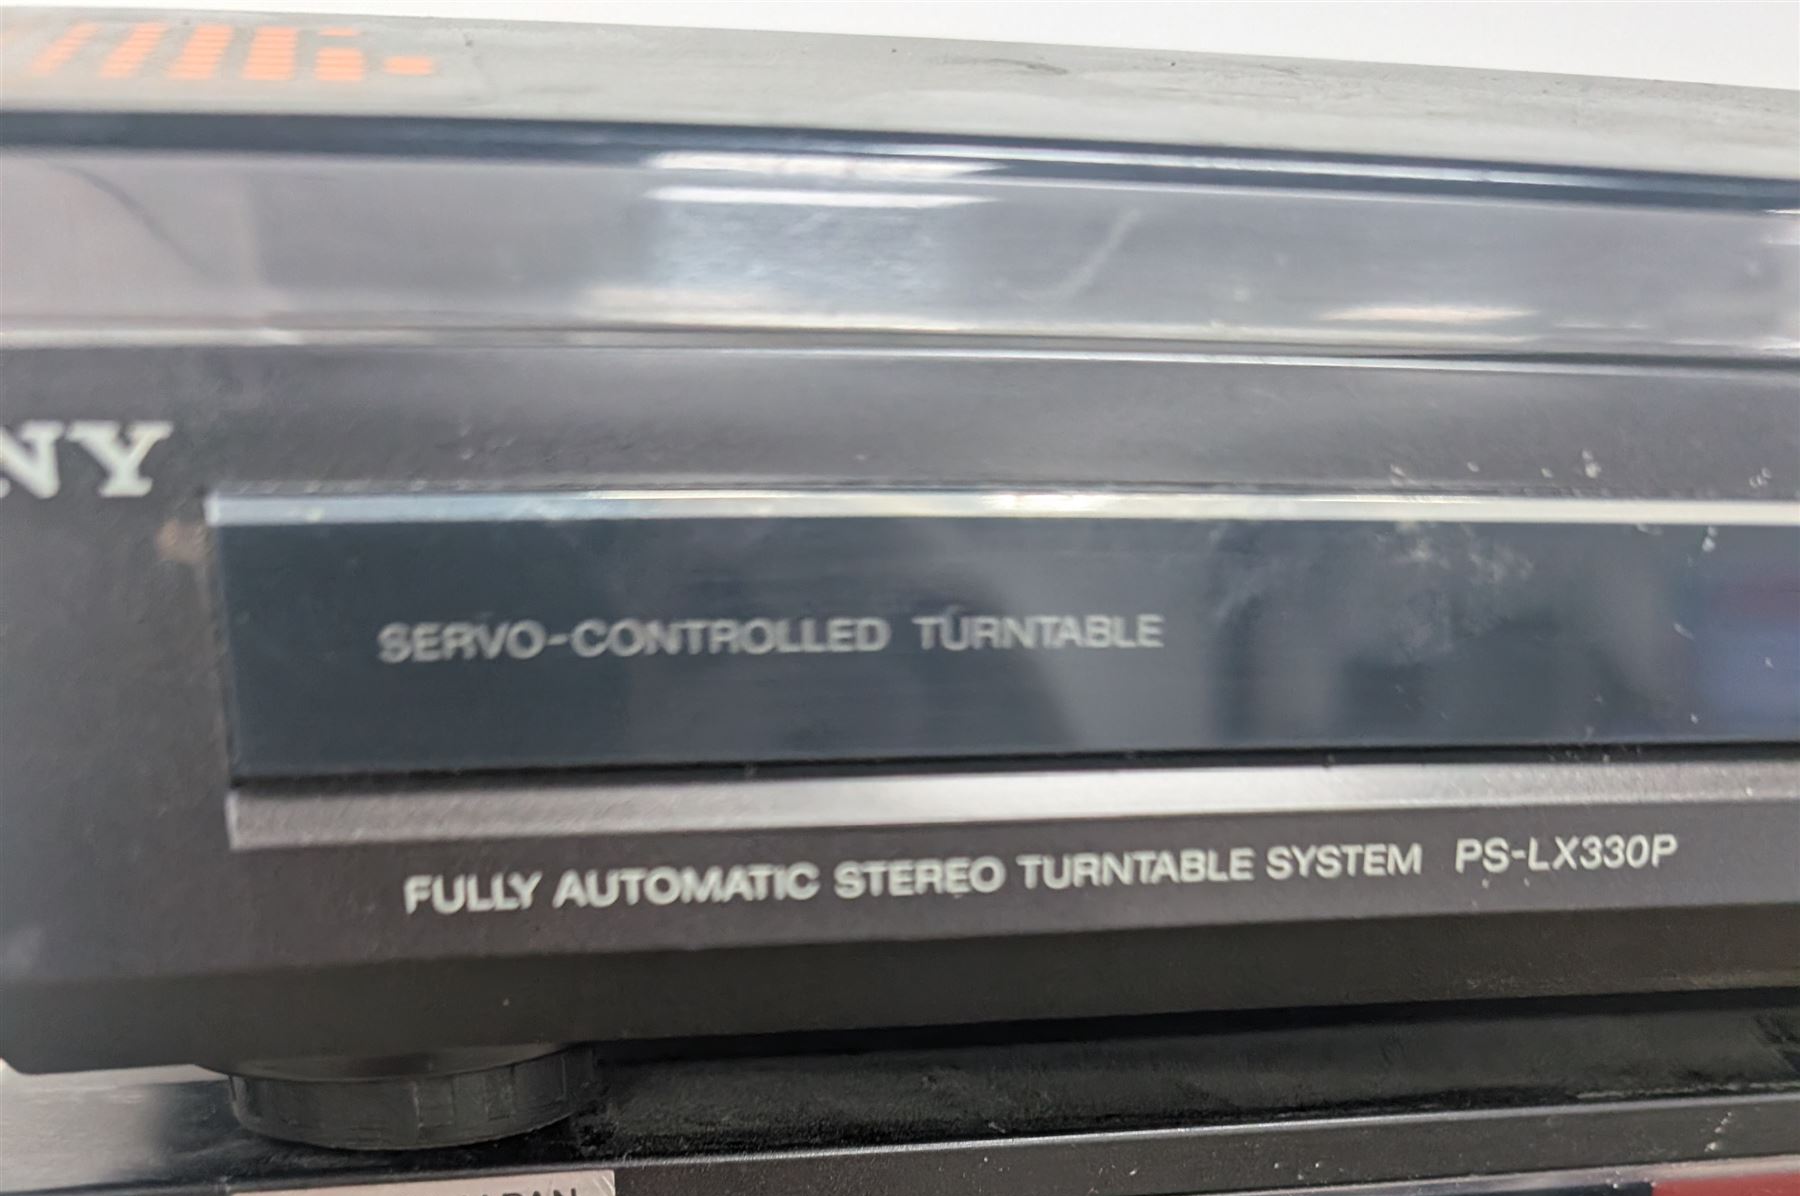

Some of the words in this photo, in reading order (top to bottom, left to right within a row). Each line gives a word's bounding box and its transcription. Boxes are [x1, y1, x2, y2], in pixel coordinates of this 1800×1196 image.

[377, 617, 891, 663] SERVO-CONTROLLED
[913, 613, 1165, 651] TURNTABLE
[404, 871, 541, 914] FULLY
[553, 861, 820, 909] AUTOMATIC
[834, 855, 1006, 898] STEREO
[1016, 847, 1256, 889] TURNTABLE
[1266, 843, 1423, 879] SYSTEM
[1455, 834, 1678, 873] PS-LX330P
